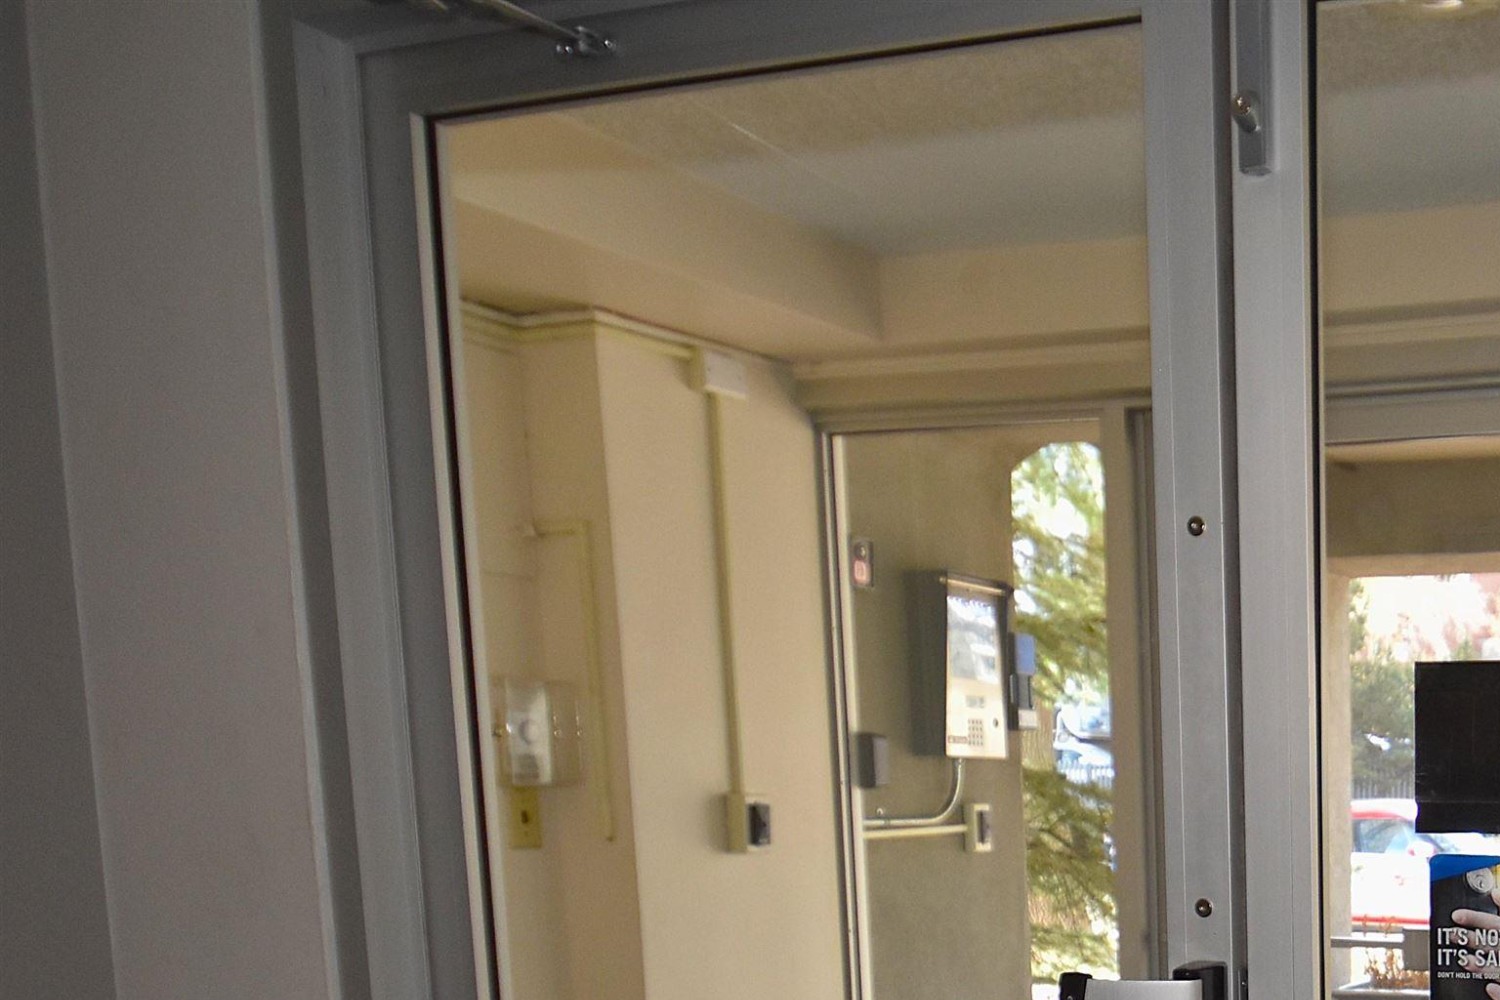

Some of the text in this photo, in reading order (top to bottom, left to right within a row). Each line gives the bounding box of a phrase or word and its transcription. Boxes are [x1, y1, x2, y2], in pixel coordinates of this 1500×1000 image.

[1437, 927, 1469, 946] IT'S
[1437, 948, 1469, 967] IT'S
[1472, 972, 1483, 980] THE
